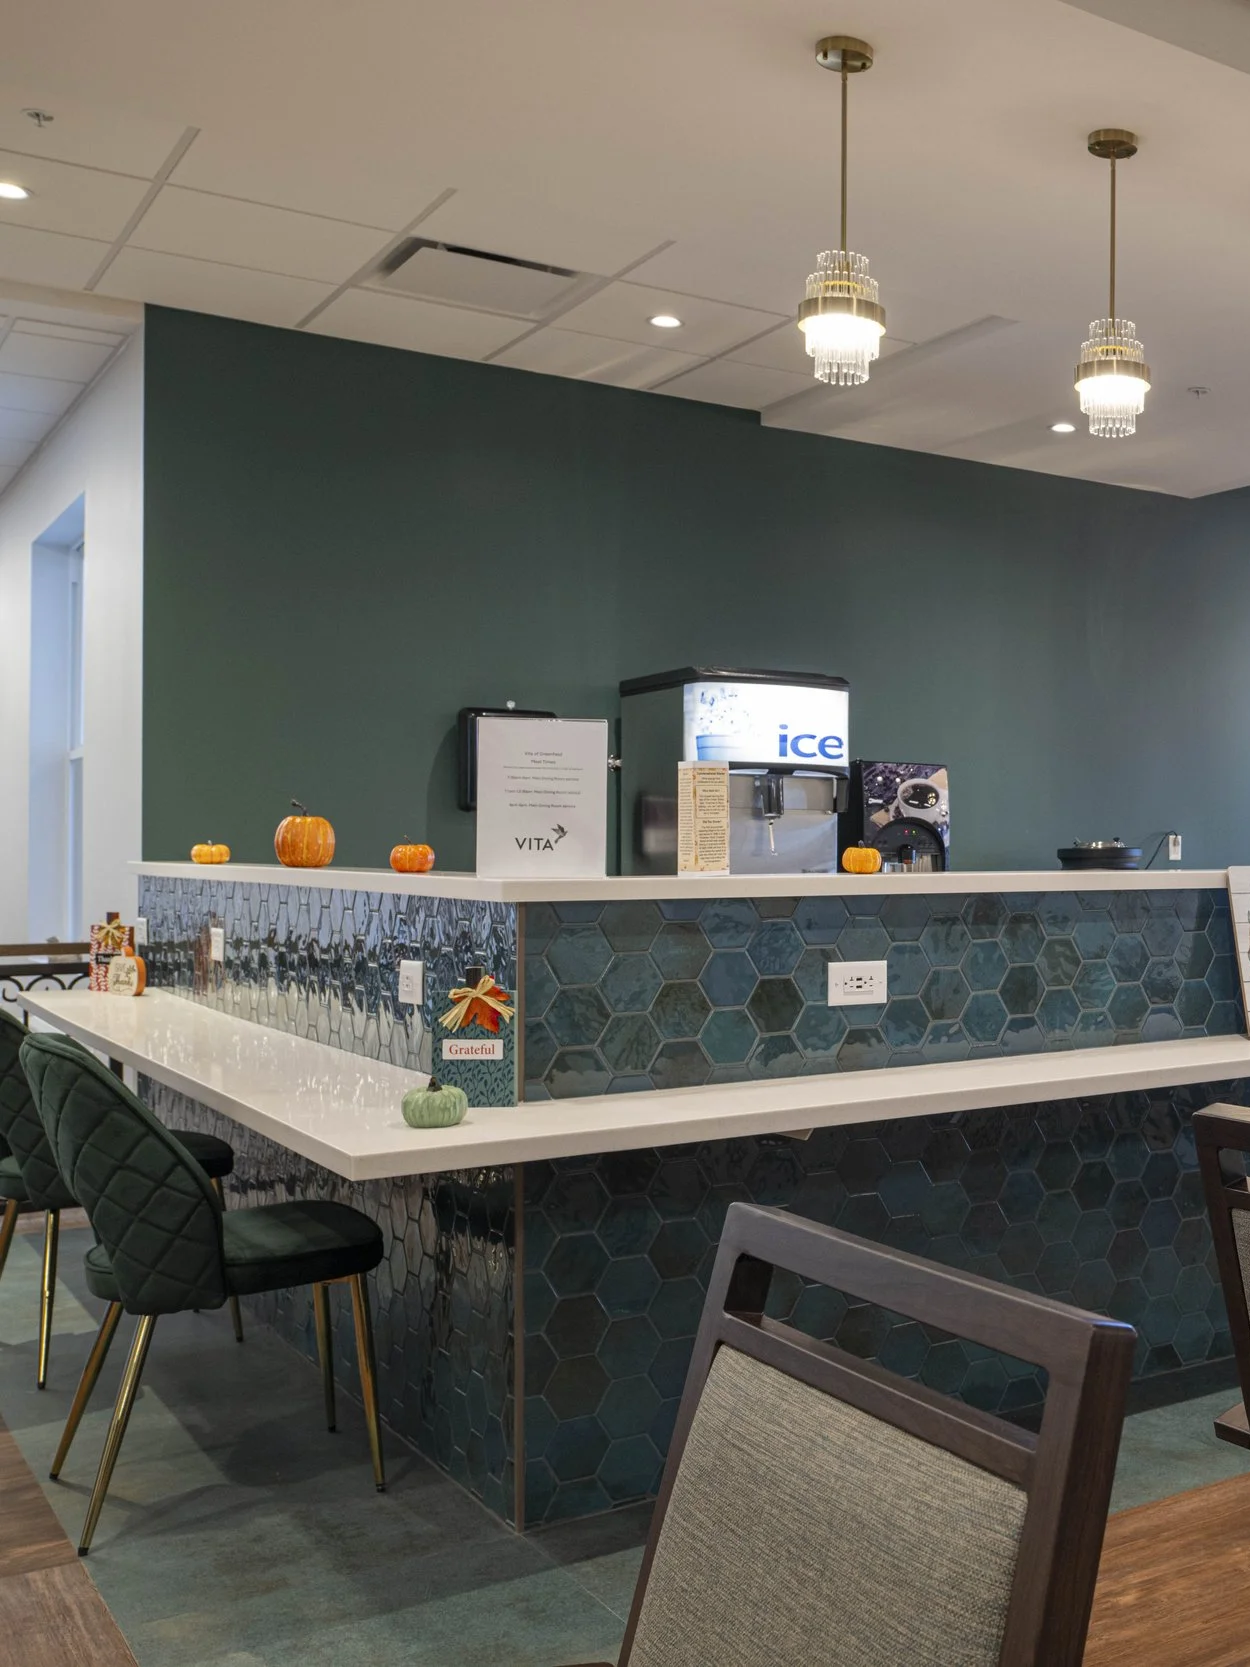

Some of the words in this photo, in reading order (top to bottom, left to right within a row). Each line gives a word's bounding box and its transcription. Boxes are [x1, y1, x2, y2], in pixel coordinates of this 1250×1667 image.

[778, 723, 844, 760] ice
[515, 837, 554, 851] VITA
[449, 1043, 495, 1055] Grateful
